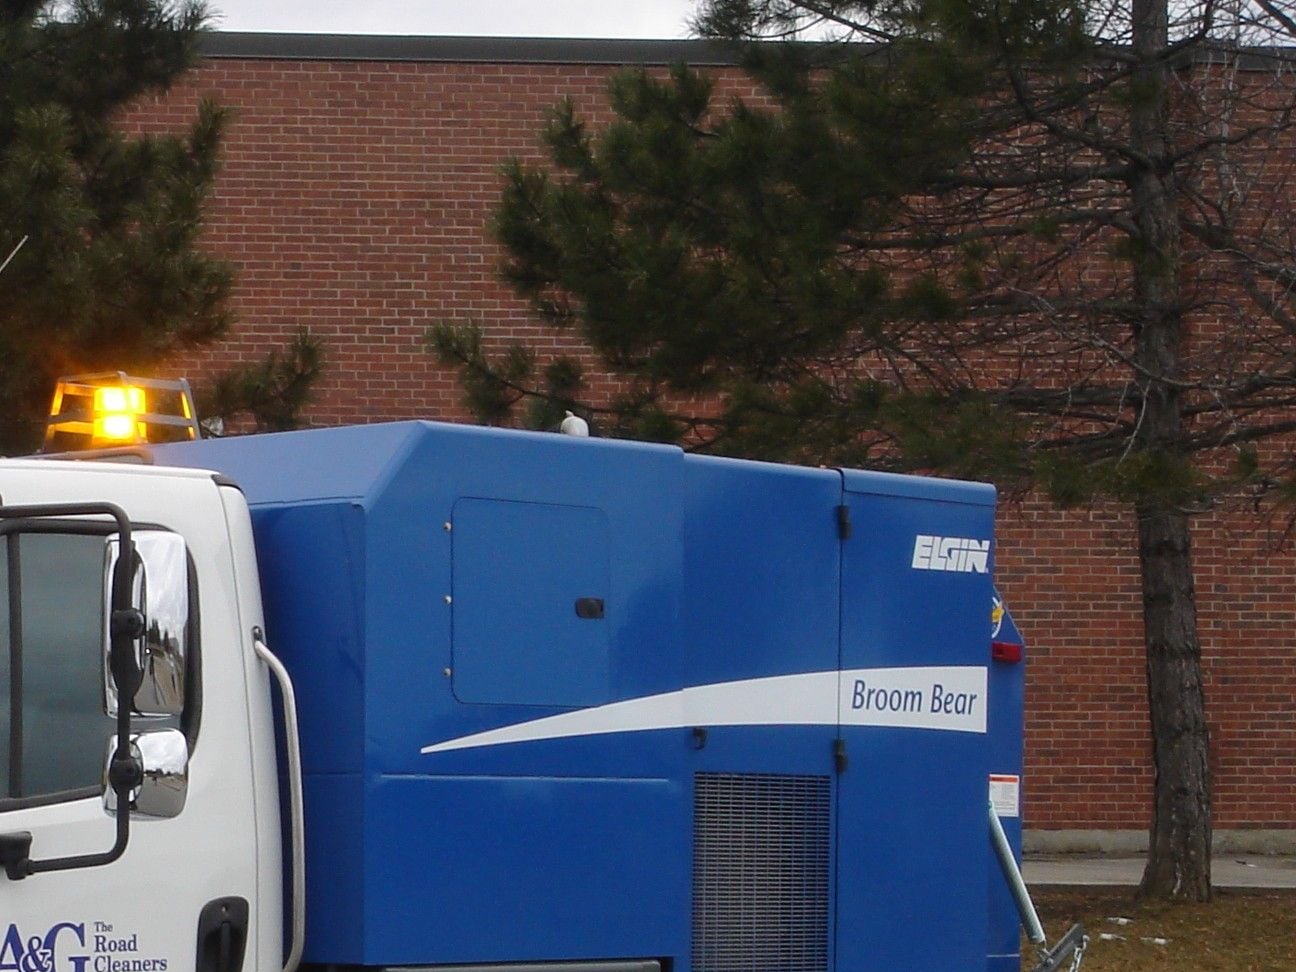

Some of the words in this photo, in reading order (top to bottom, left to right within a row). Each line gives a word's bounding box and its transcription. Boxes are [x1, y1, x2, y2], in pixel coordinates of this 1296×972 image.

[912, 534, 990, 573] ELGIN
[852, 679, 922, 713] Broom
[930, 684, 977, 715] Bear
[94, 922, 113, 933] The
[94, 934, 138, 953] Road
